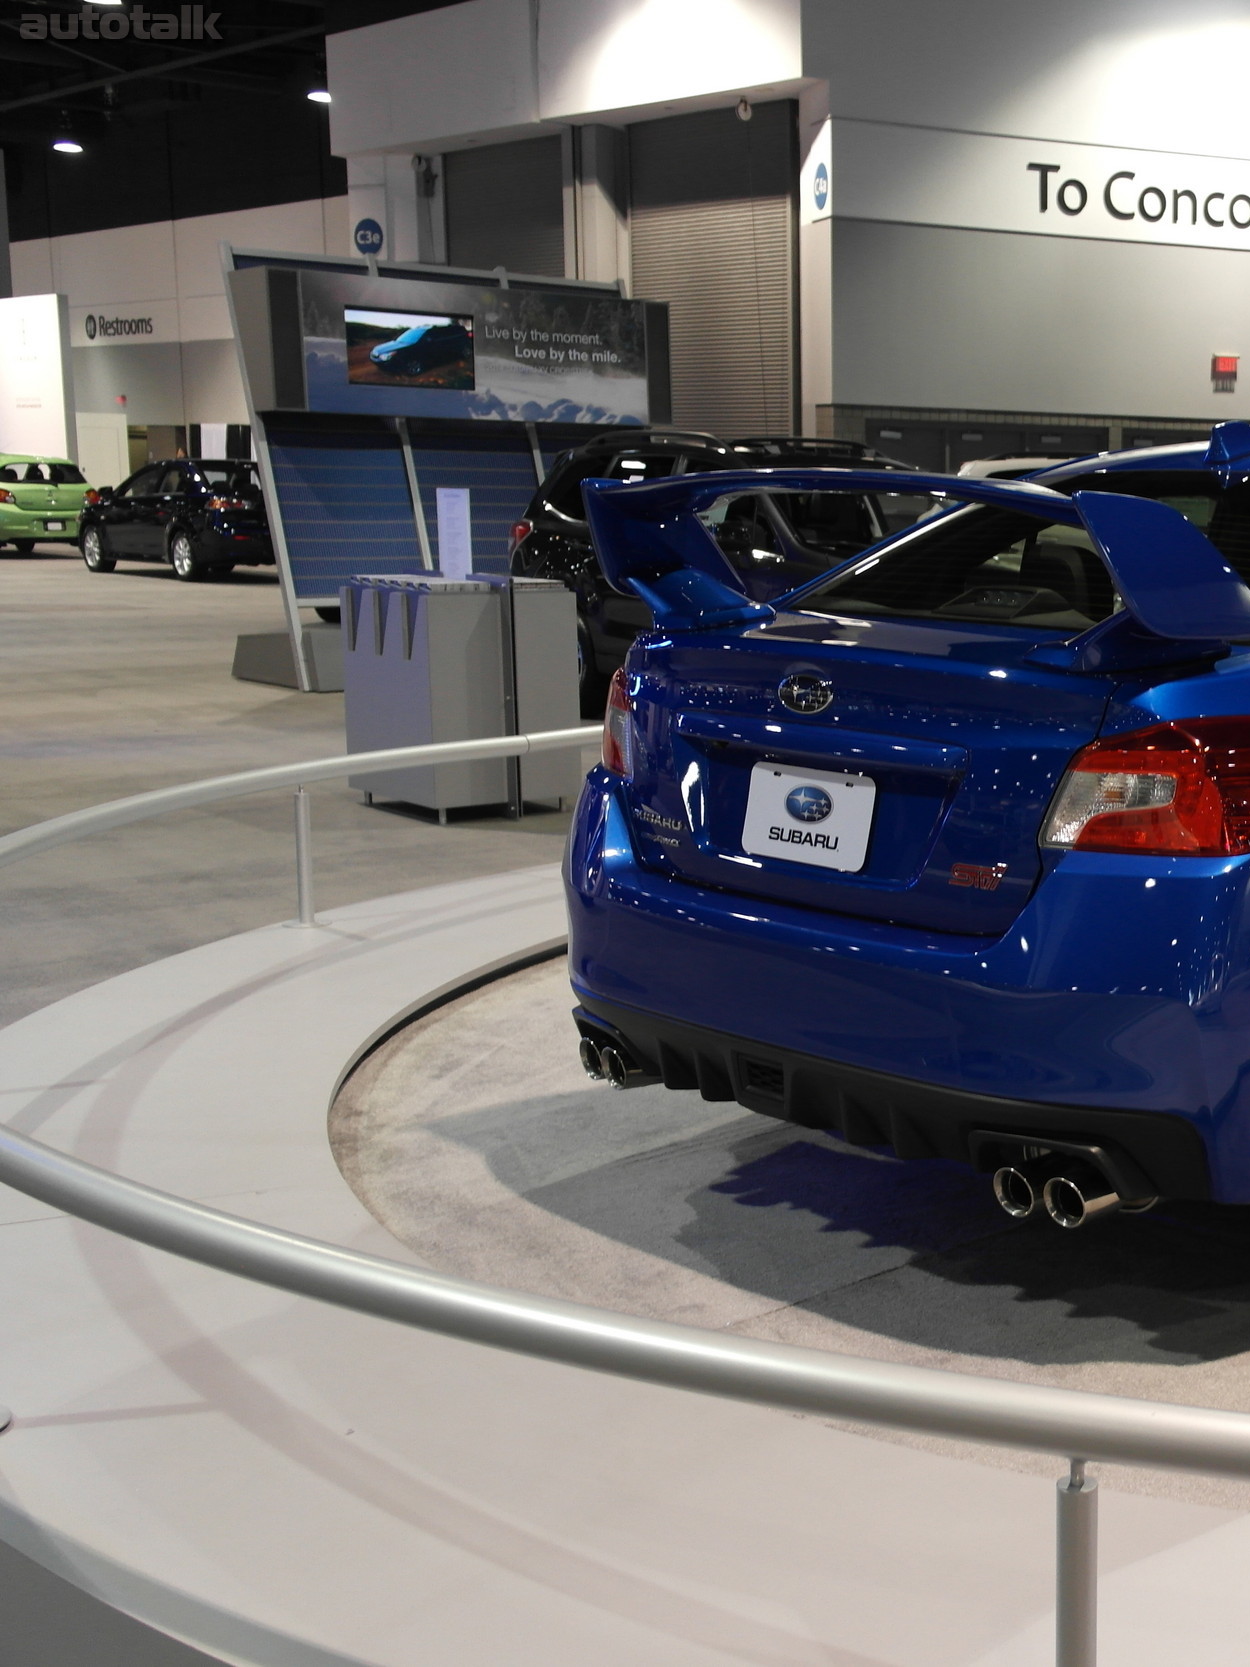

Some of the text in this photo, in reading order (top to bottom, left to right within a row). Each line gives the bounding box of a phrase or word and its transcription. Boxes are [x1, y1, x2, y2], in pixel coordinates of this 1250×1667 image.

[1026, 162, 1088, 217] To
[356, 230, 380, 244] C3e
[98, 315, 153, 337] Restrooms
[485, 325, 603, 345] Live by the moment.
[514, 345, 622, 363] Love by the mile.
[768, 826, 839, 850] SUBARU
